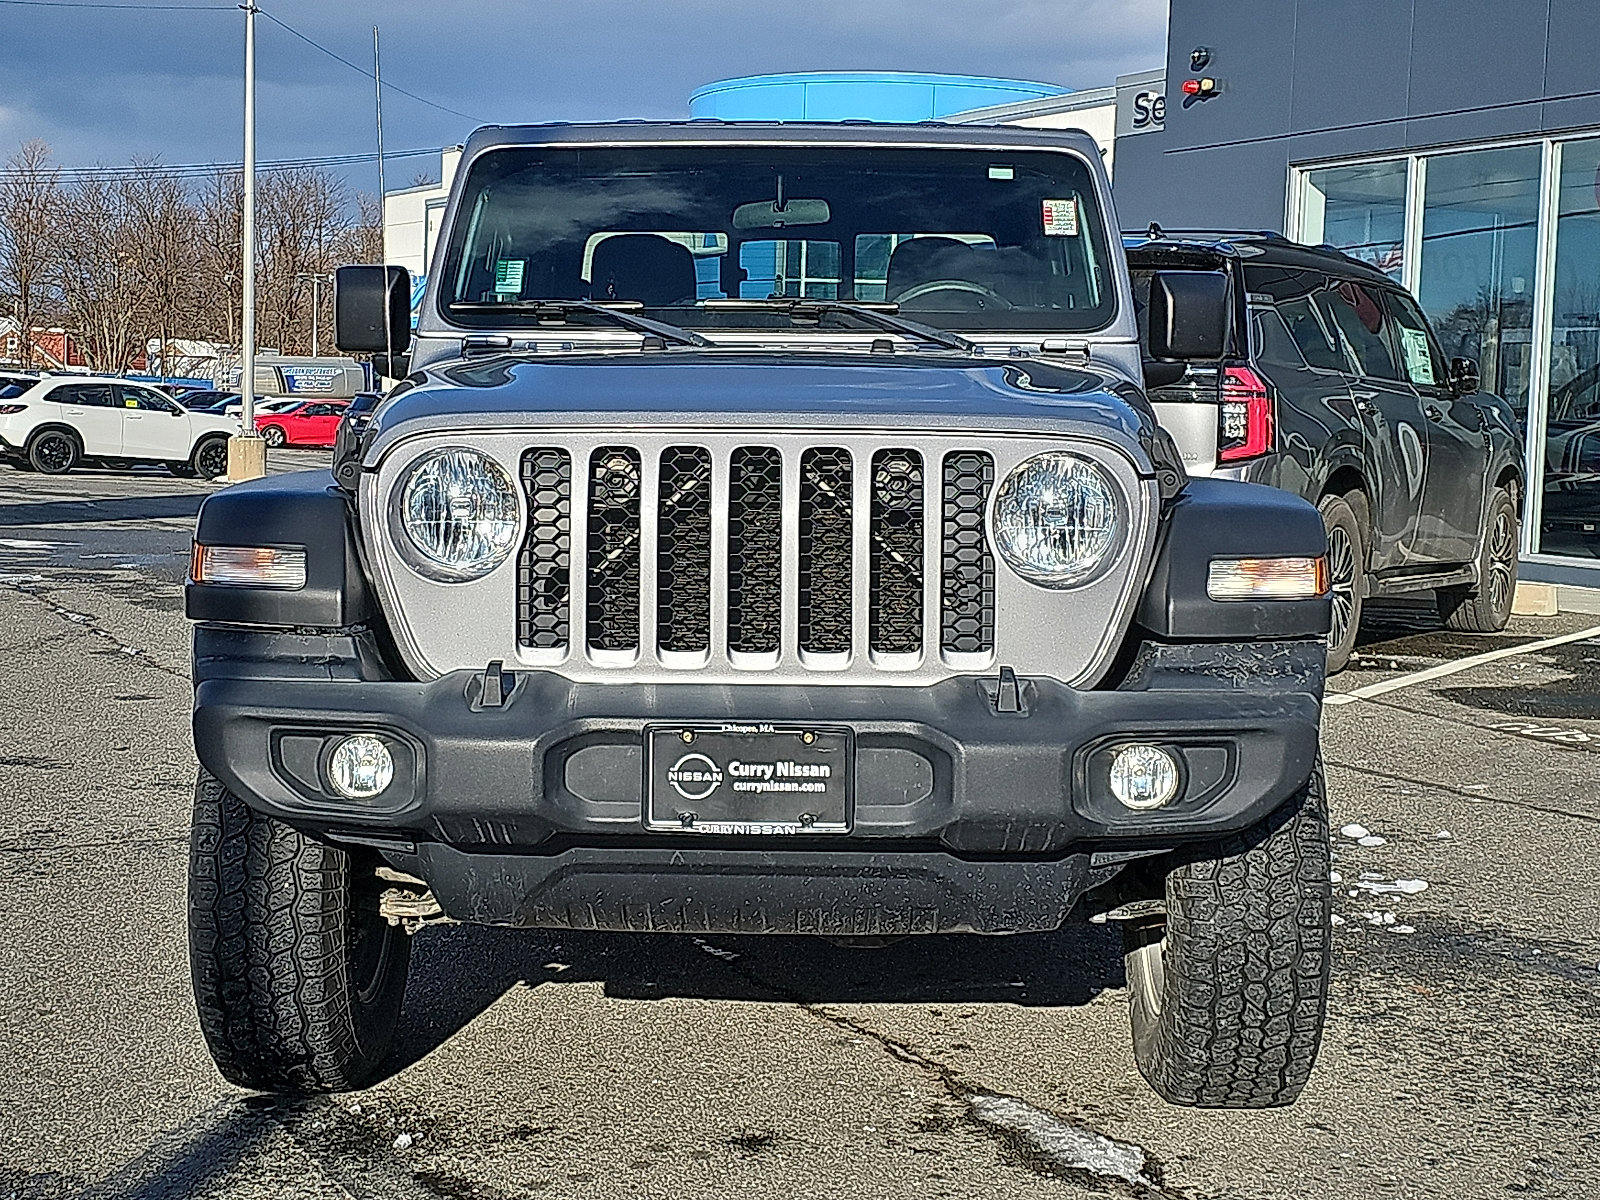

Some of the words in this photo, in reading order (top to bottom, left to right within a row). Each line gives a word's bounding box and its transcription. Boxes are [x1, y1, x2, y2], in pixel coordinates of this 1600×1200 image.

[760, 725, 775, 733] MA
[728, 761, 774, 780] Curry
[776, 761, 831, 778] Nissan
[668, 772, 723, 782] NISSAN
[733, 779, 826, 794] currynissan.com
